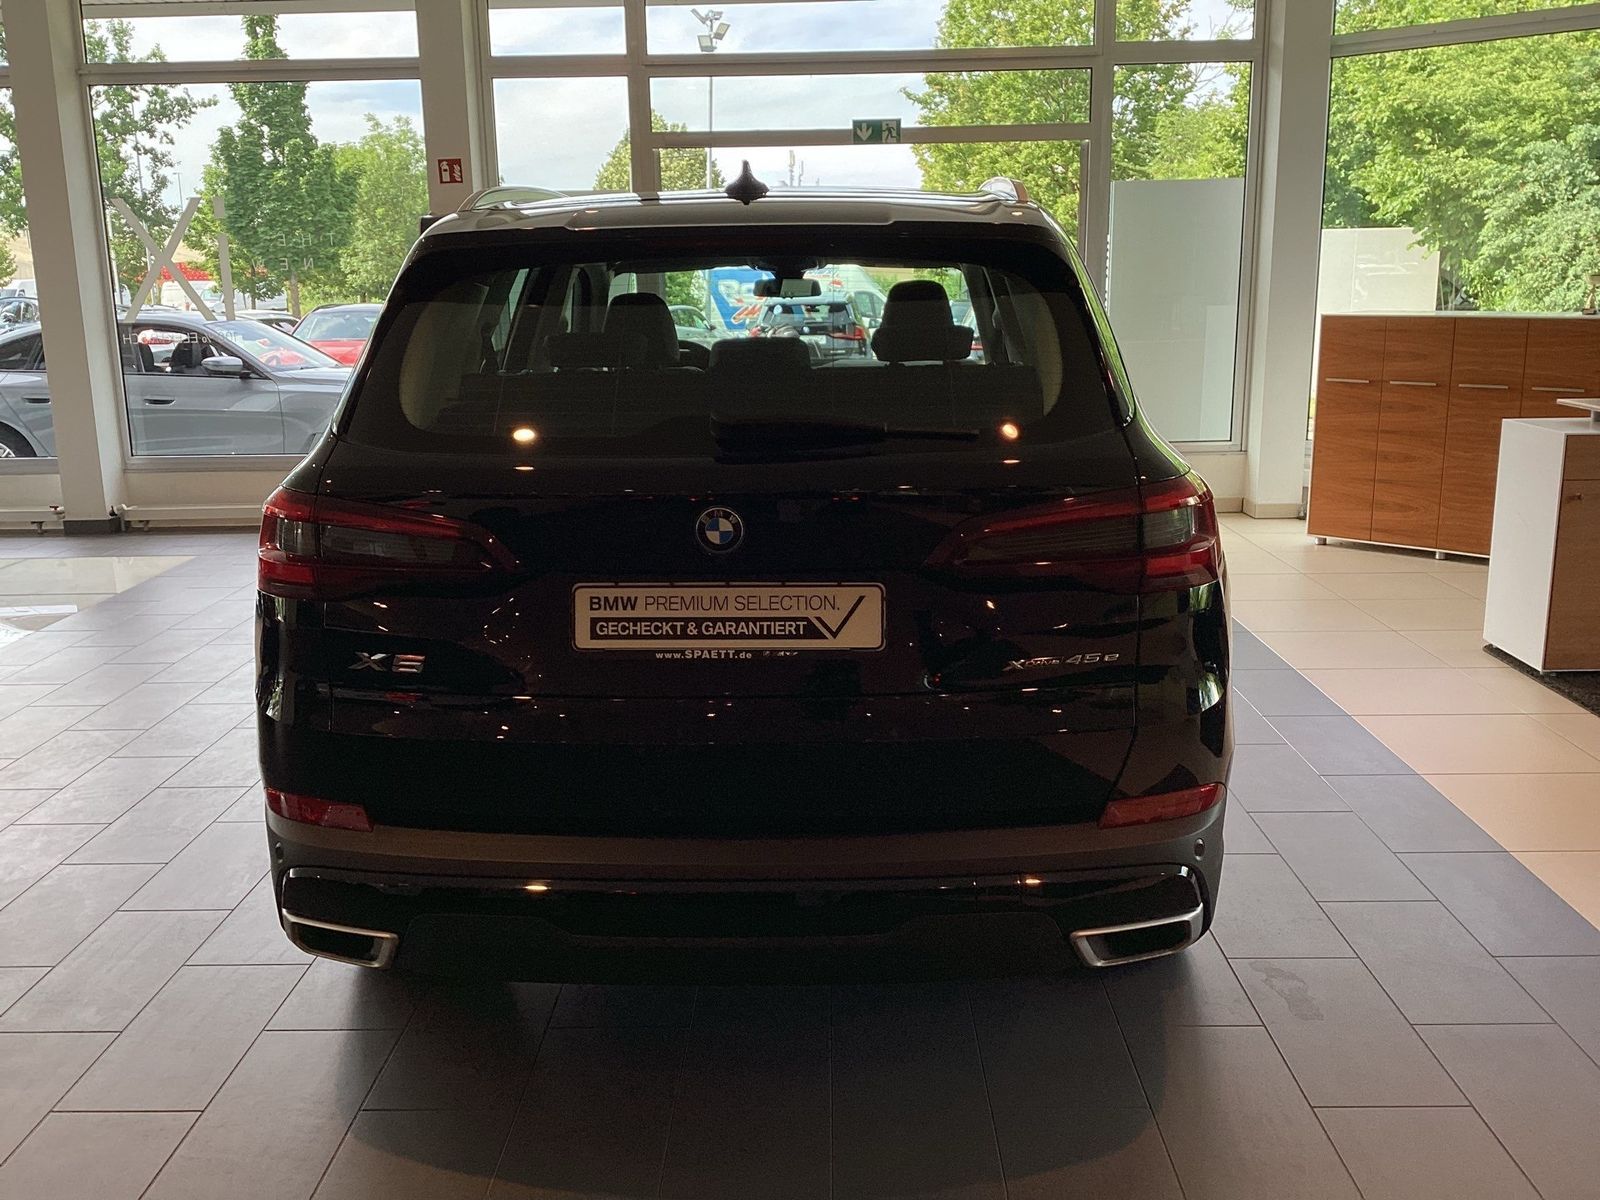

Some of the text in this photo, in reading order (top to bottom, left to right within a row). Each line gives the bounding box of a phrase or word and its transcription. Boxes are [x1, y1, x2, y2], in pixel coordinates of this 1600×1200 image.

[589, 595, 840, 611] BMW PREMIUM SELECTION.
[596, 621, 807, 636] GECHECKT & GARANTIERT
[655, 650, 752, 660] www.SPAETT.de
